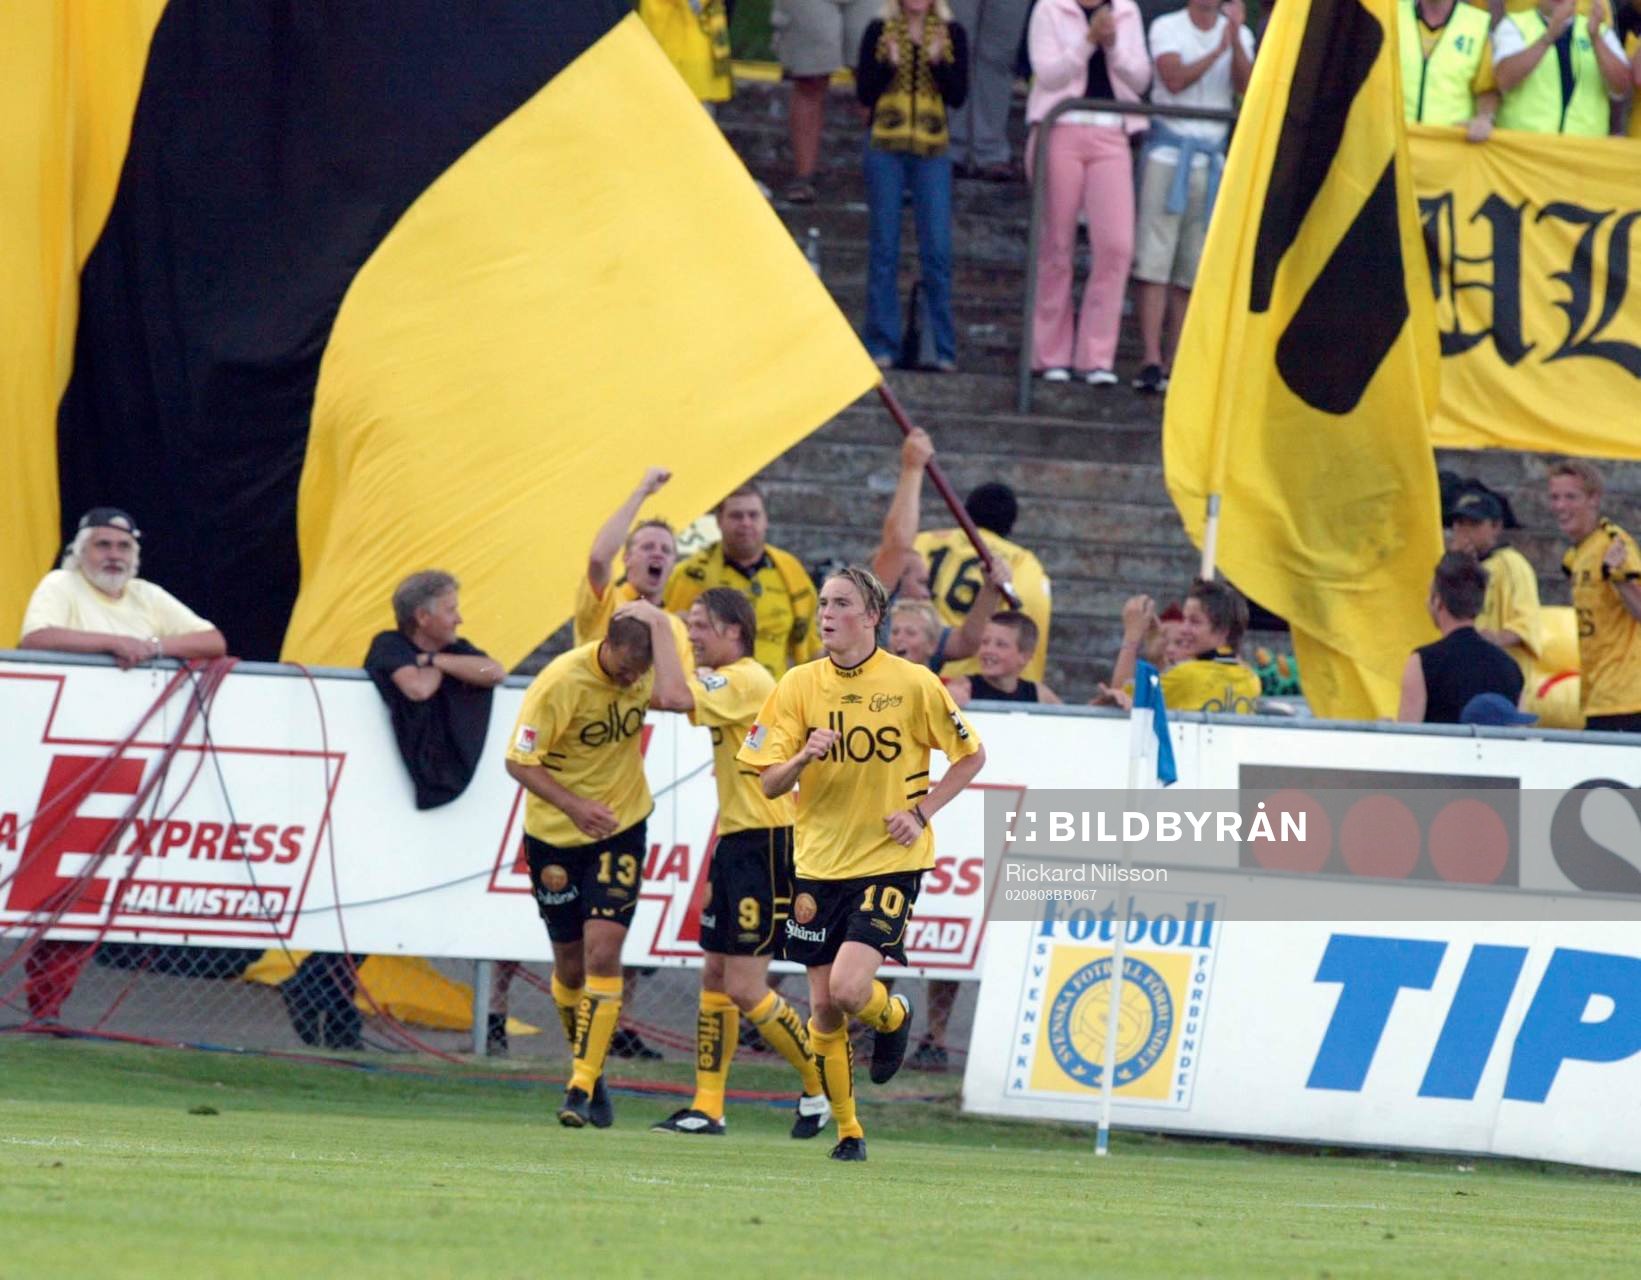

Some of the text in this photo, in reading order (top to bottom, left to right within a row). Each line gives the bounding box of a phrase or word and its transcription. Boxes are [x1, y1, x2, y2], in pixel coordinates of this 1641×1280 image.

[927, 546, 984, 614] 16
[597, 851, 637, 887] 13
[116, 884, 285, 918] HALMSTAD
[738, 896, 760, 931] 9
[860, 884, 905, 918] 10
[1038, 895, 1217, 949] Fotboll
[701, 1015, 721, 1067] ffice
